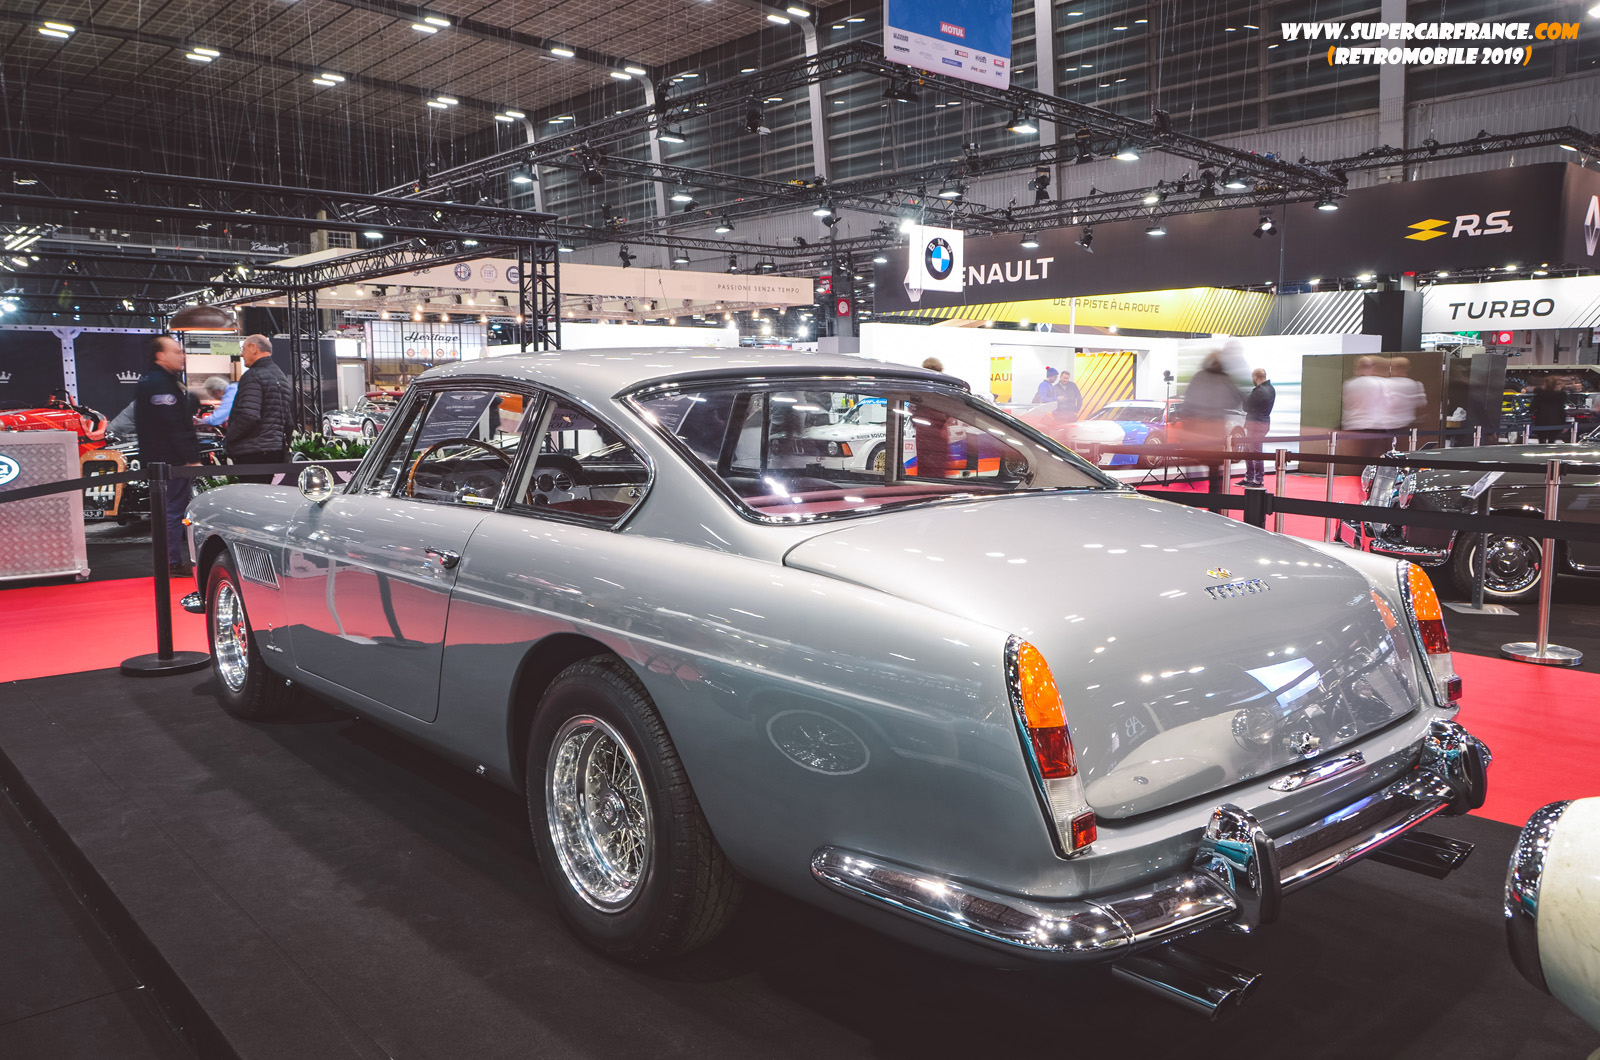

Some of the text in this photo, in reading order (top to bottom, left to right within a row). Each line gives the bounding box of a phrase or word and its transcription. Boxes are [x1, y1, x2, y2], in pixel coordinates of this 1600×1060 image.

[941, 23, 964, 36] MOTUL
[1452, 210, 1513, 238] R.S.
[928, 238, 953, 254] BMW
[717, 284, 751, 292] PASSIONE
[1083, 299, 1109, 309] PISTE
[1118, 302, 1130, 311] LA
[1131, 303, 1160, 313] ROUTE
[1449, 298, 1555, 320] TURBO
[404, 331, 458, 343] Heritage
[904, 443, 914, 451] GT2
